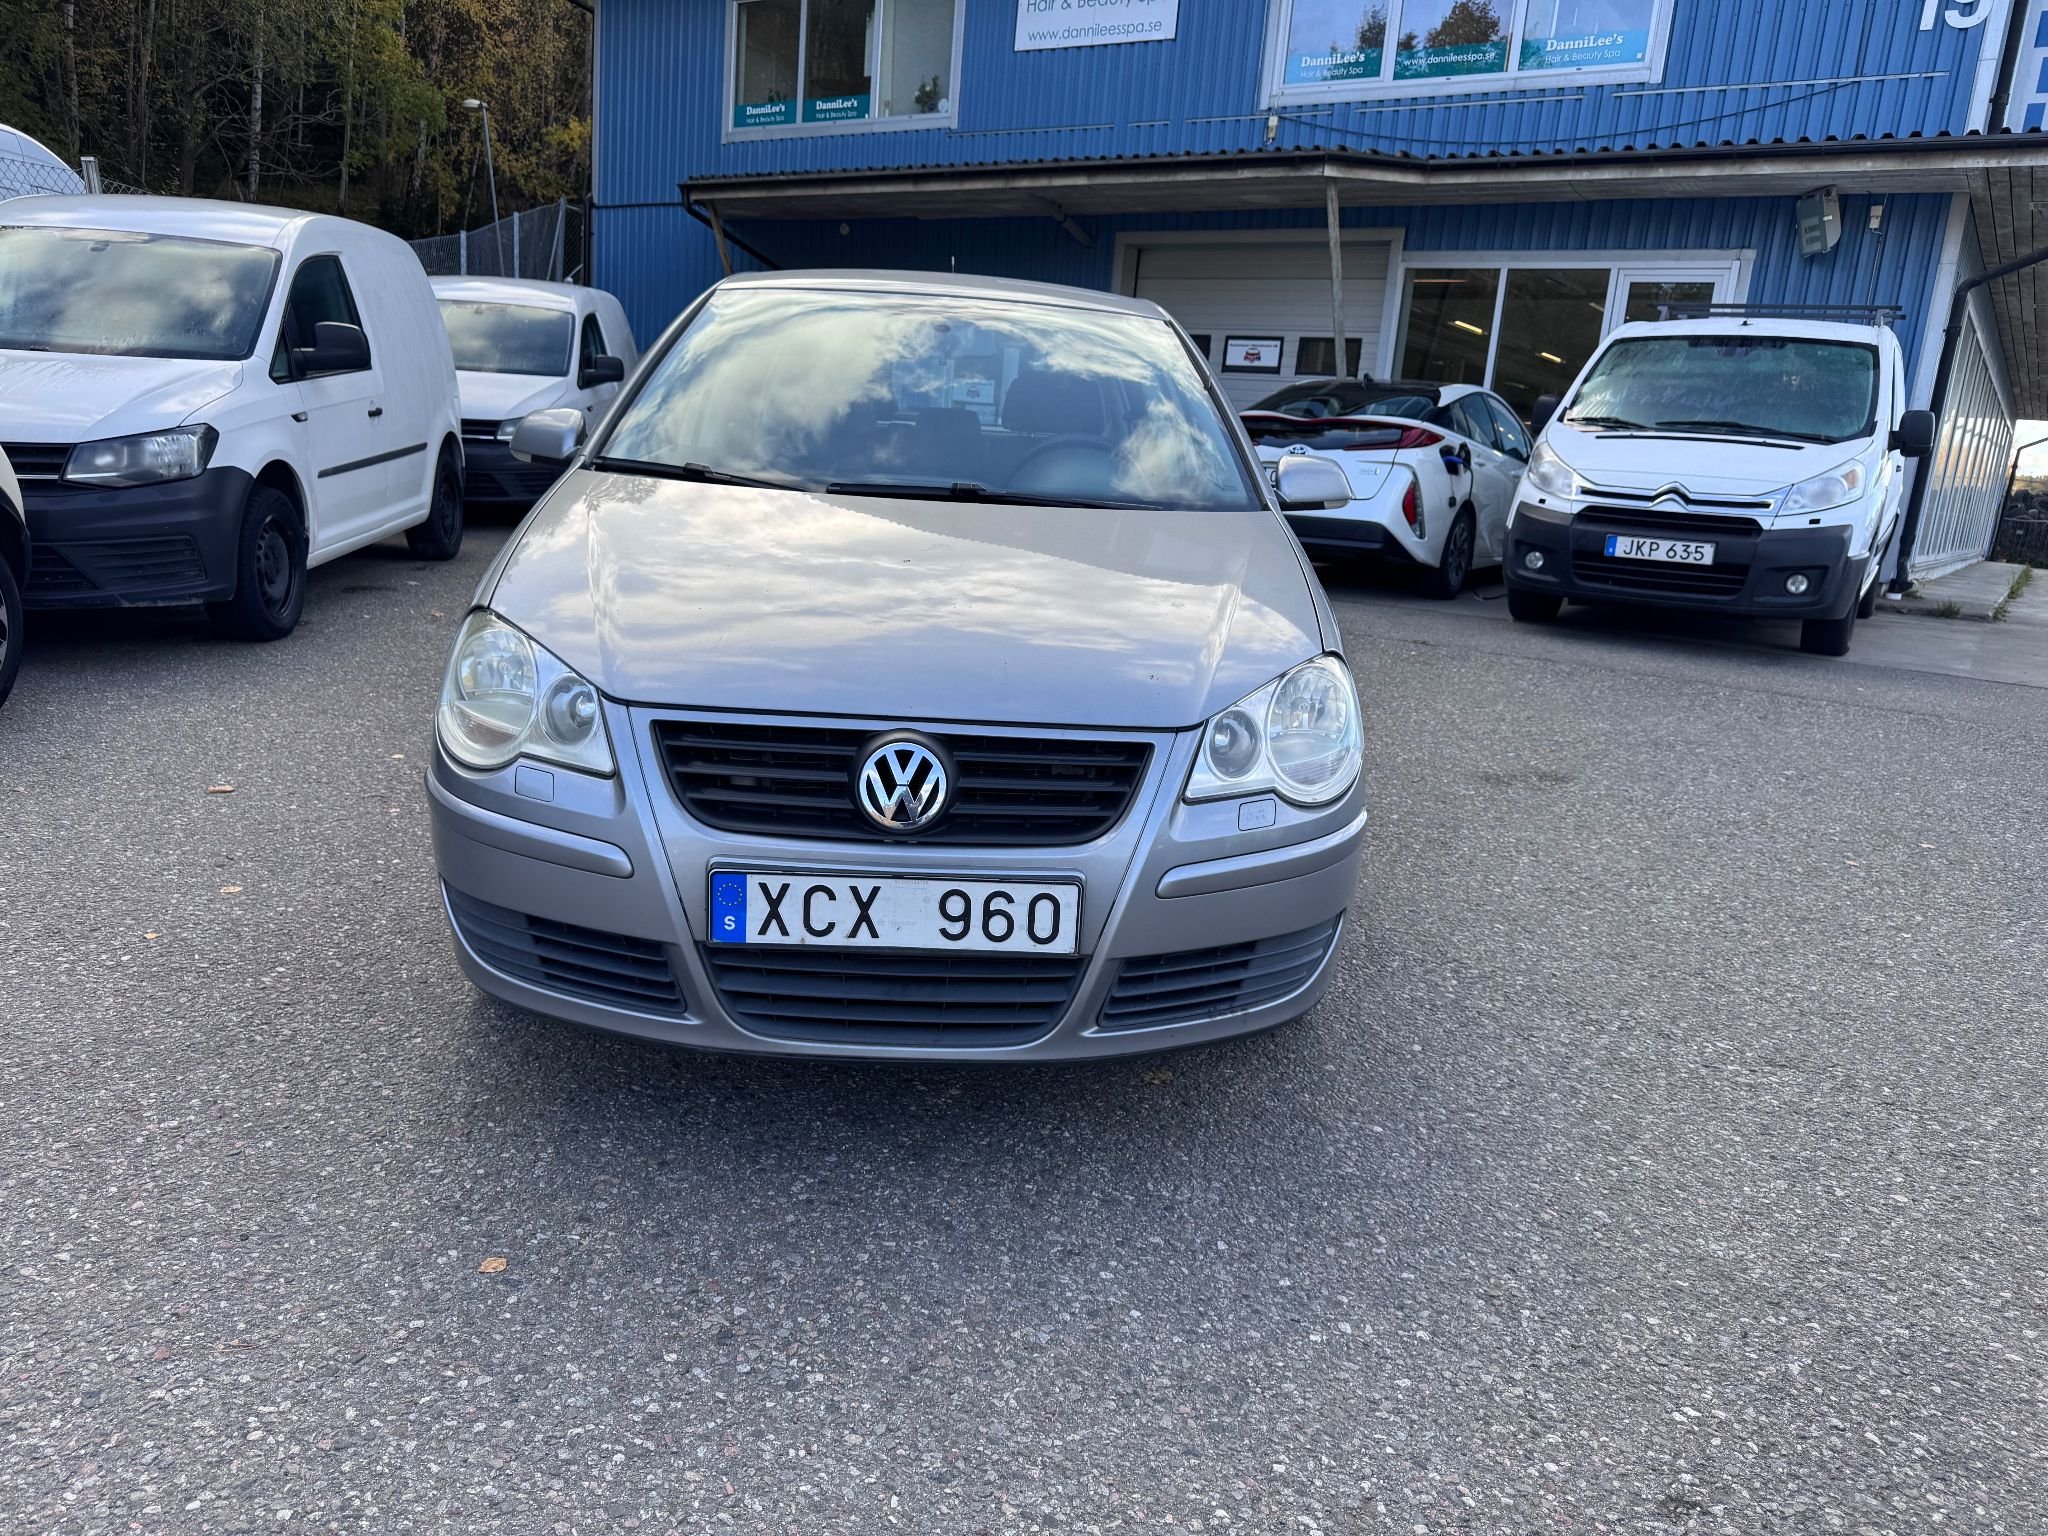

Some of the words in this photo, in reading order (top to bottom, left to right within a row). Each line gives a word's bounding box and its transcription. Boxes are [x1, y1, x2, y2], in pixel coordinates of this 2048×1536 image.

[1027, 20, 1163, 41] www.dannileesspa.se
[1545, 33, 1624, 51] DanniLee's
[1301, 51, 1366, 68] DanniLee's
[1403, 51, 1496, 67] www.dannileesspa.se
[1545, 55, 1561, 64] Hair
[1563, 53, 1570, 62] &
[1572, 51, 1602, 61] Beauty
[1604, 49, 1621, 59] Spa
[1322, 68, 1348, 77] Beauty
[1349, 66, 1364, 75] Spa
[746, 103, 785, 115] DanniLee's
[816, 98, 858, 110] DanniLee's
[1623, 539, 1660, 557] JKP
[1666, 543, 1705, 561] 635
[757, 882, 882, 938] XCX
[938, 888, 1060, 944] 960
[724, 915, 736, 930] S
